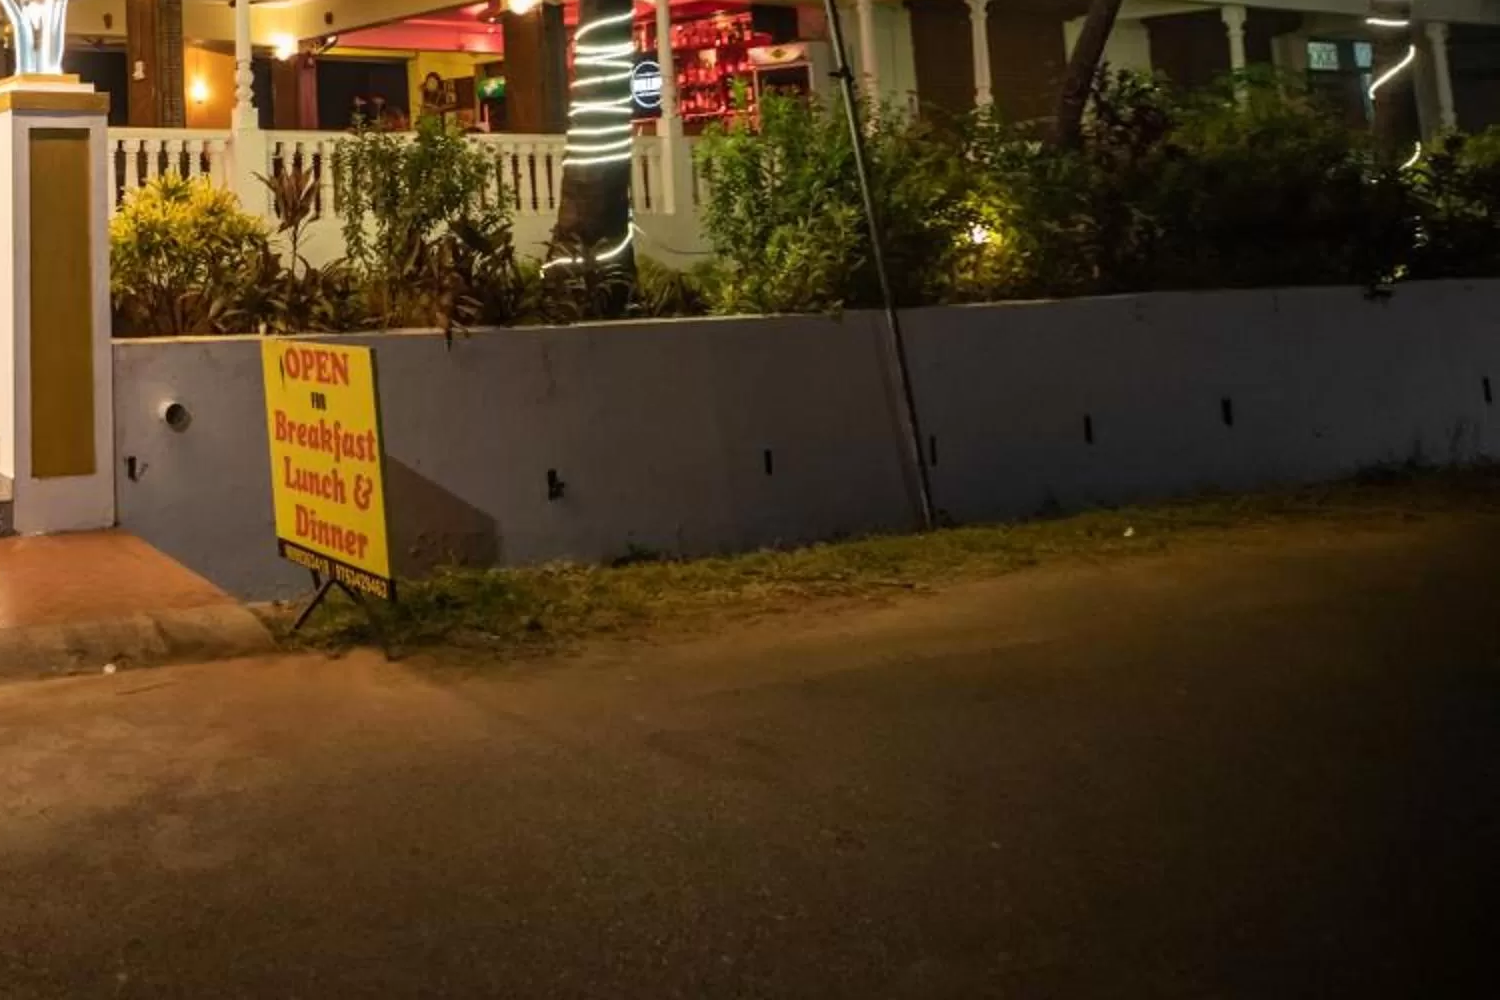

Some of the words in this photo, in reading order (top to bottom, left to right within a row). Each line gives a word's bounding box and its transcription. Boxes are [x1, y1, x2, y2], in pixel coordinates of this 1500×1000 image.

[284, 348, 349, 386] OPEN
[274, 409, 376, 462] Breakfast
[284, 456, 346, 504] Lunch
[353, 474, 373, 510] &
[295, 504, 368, 559] Dinner
